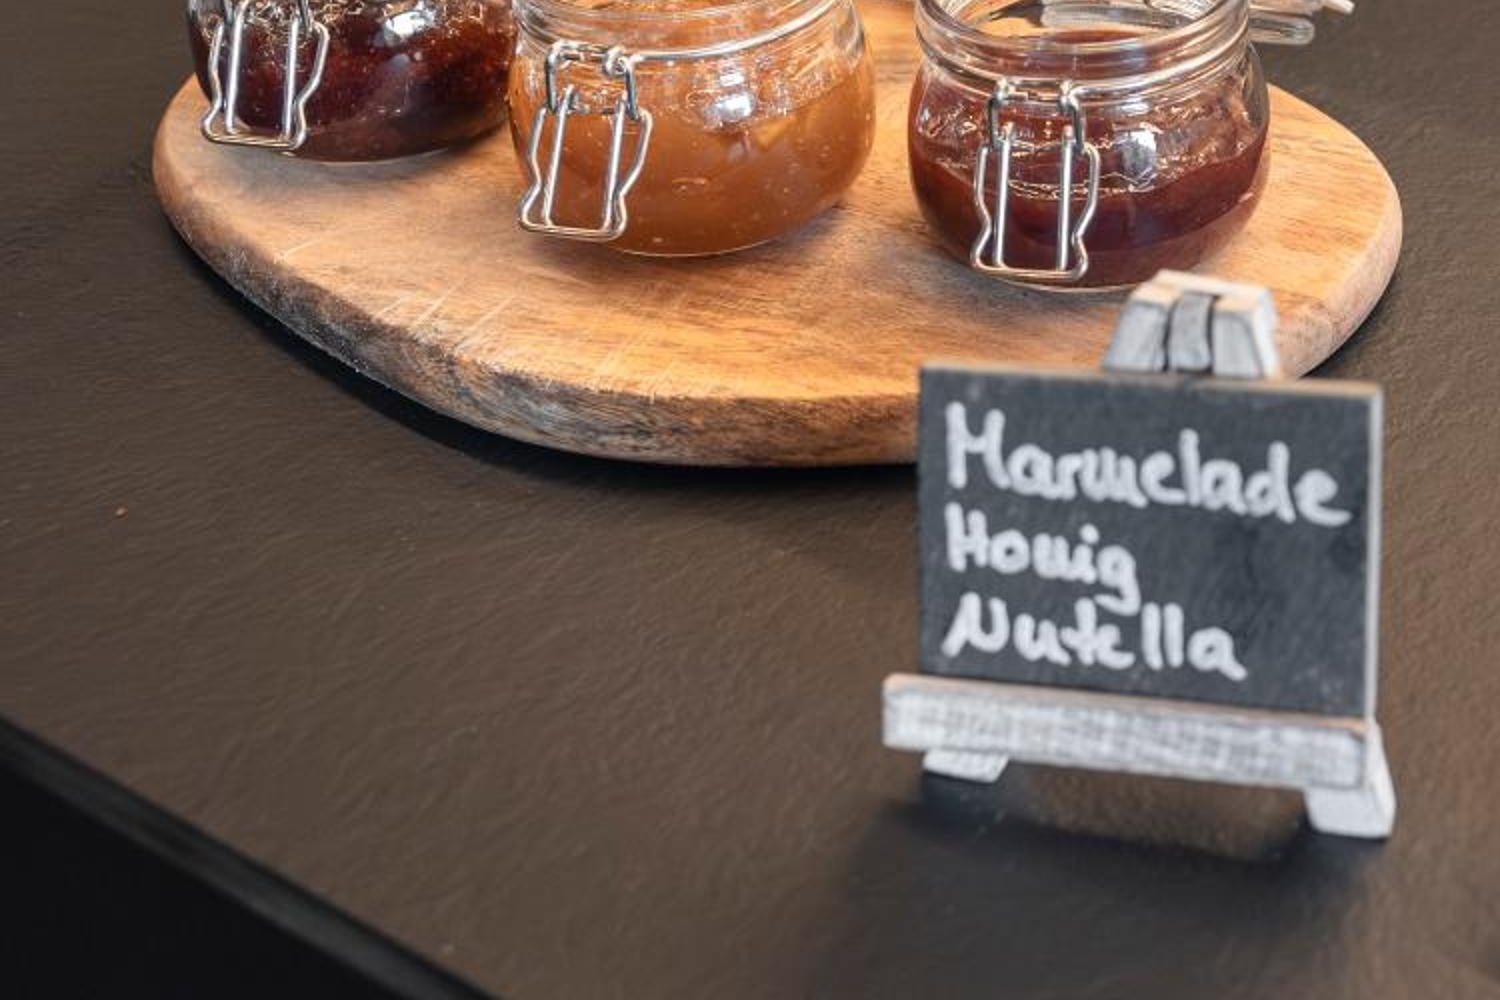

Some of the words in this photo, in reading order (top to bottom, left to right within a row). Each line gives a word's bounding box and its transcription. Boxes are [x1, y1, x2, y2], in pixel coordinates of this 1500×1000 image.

[945, 402, 1353, 526] Marmelade
[945, 502, 1140, 616] Honig
[942, 592, 1249, 682] Nutella
